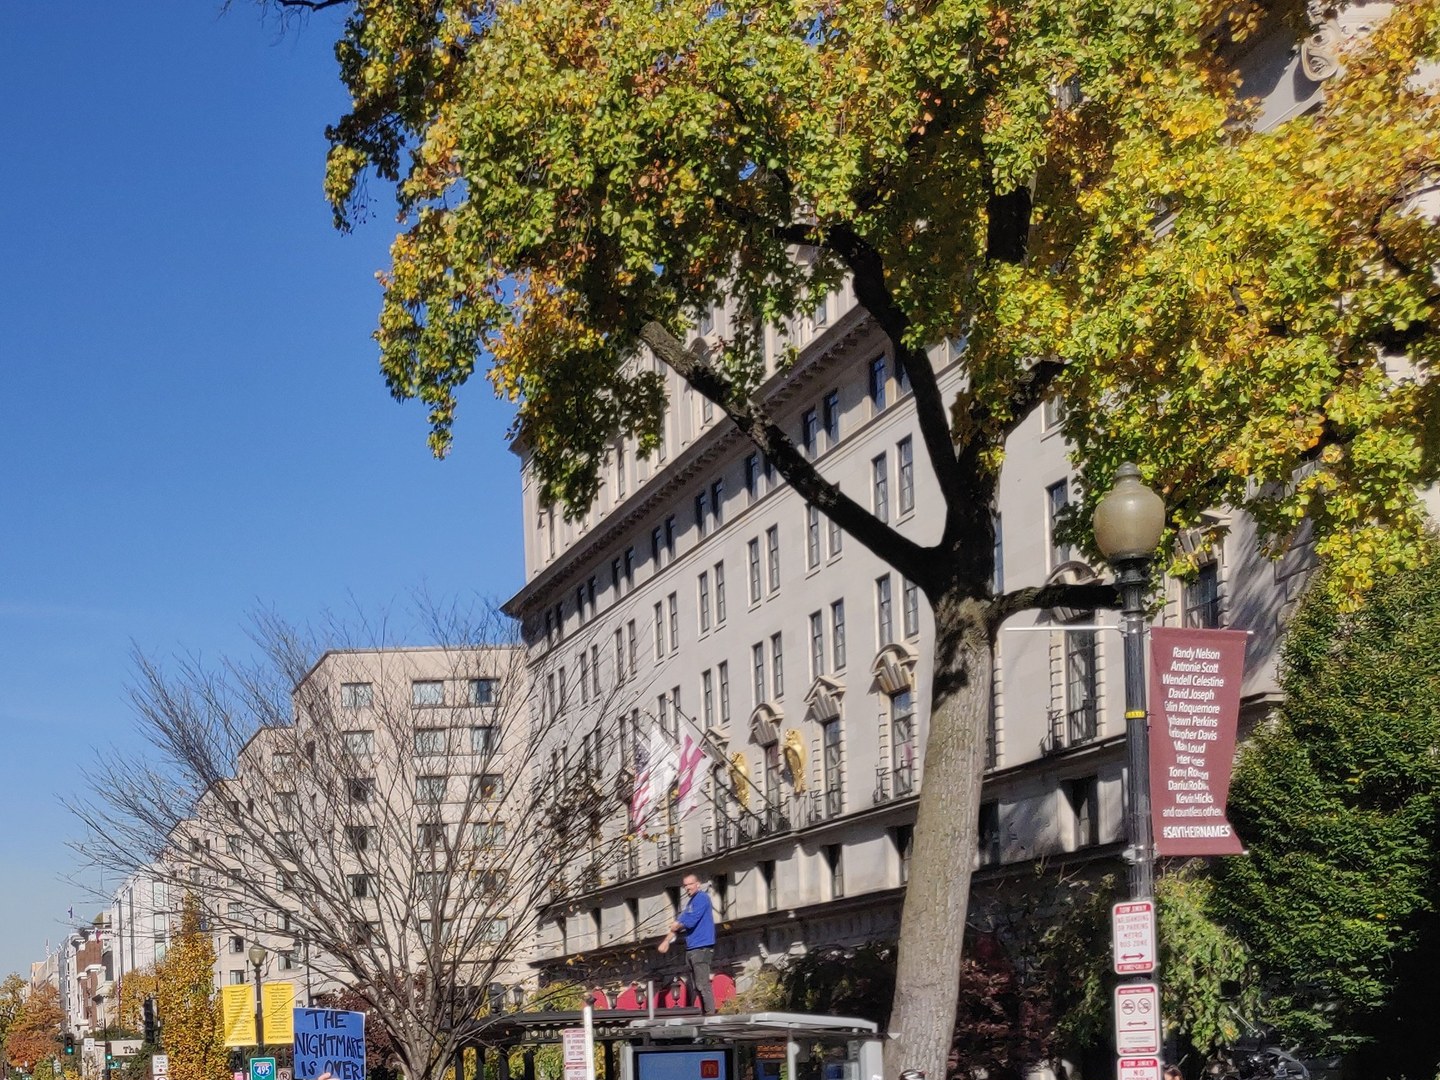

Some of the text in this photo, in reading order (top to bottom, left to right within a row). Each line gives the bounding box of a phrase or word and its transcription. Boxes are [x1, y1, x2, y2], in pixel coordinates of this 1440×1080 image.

[1172, 646, 1220, 661] Randy Nelson
[1170, 660, 1219, 673] Antronie Scott
[1162, 673, 1224, 687] Wendell Celestine
[1168, 687, 1215, 702] David Joseph
[1178, 702, 1220, 715] Roquemore
[1191, 715, 1218, 727] Perkins
[1197, 729, 1217, 741] Davis
[1162, 806, 1175, 817] and
[305, 1010, 350, 1029] THE
[294, 1032, 364, 1059] NIGHTMARE
[256, 1065, 270, 1075] 495
[301, 1060, 317, 1077] IS
[1133, 1069, 1145, 1077] NO
